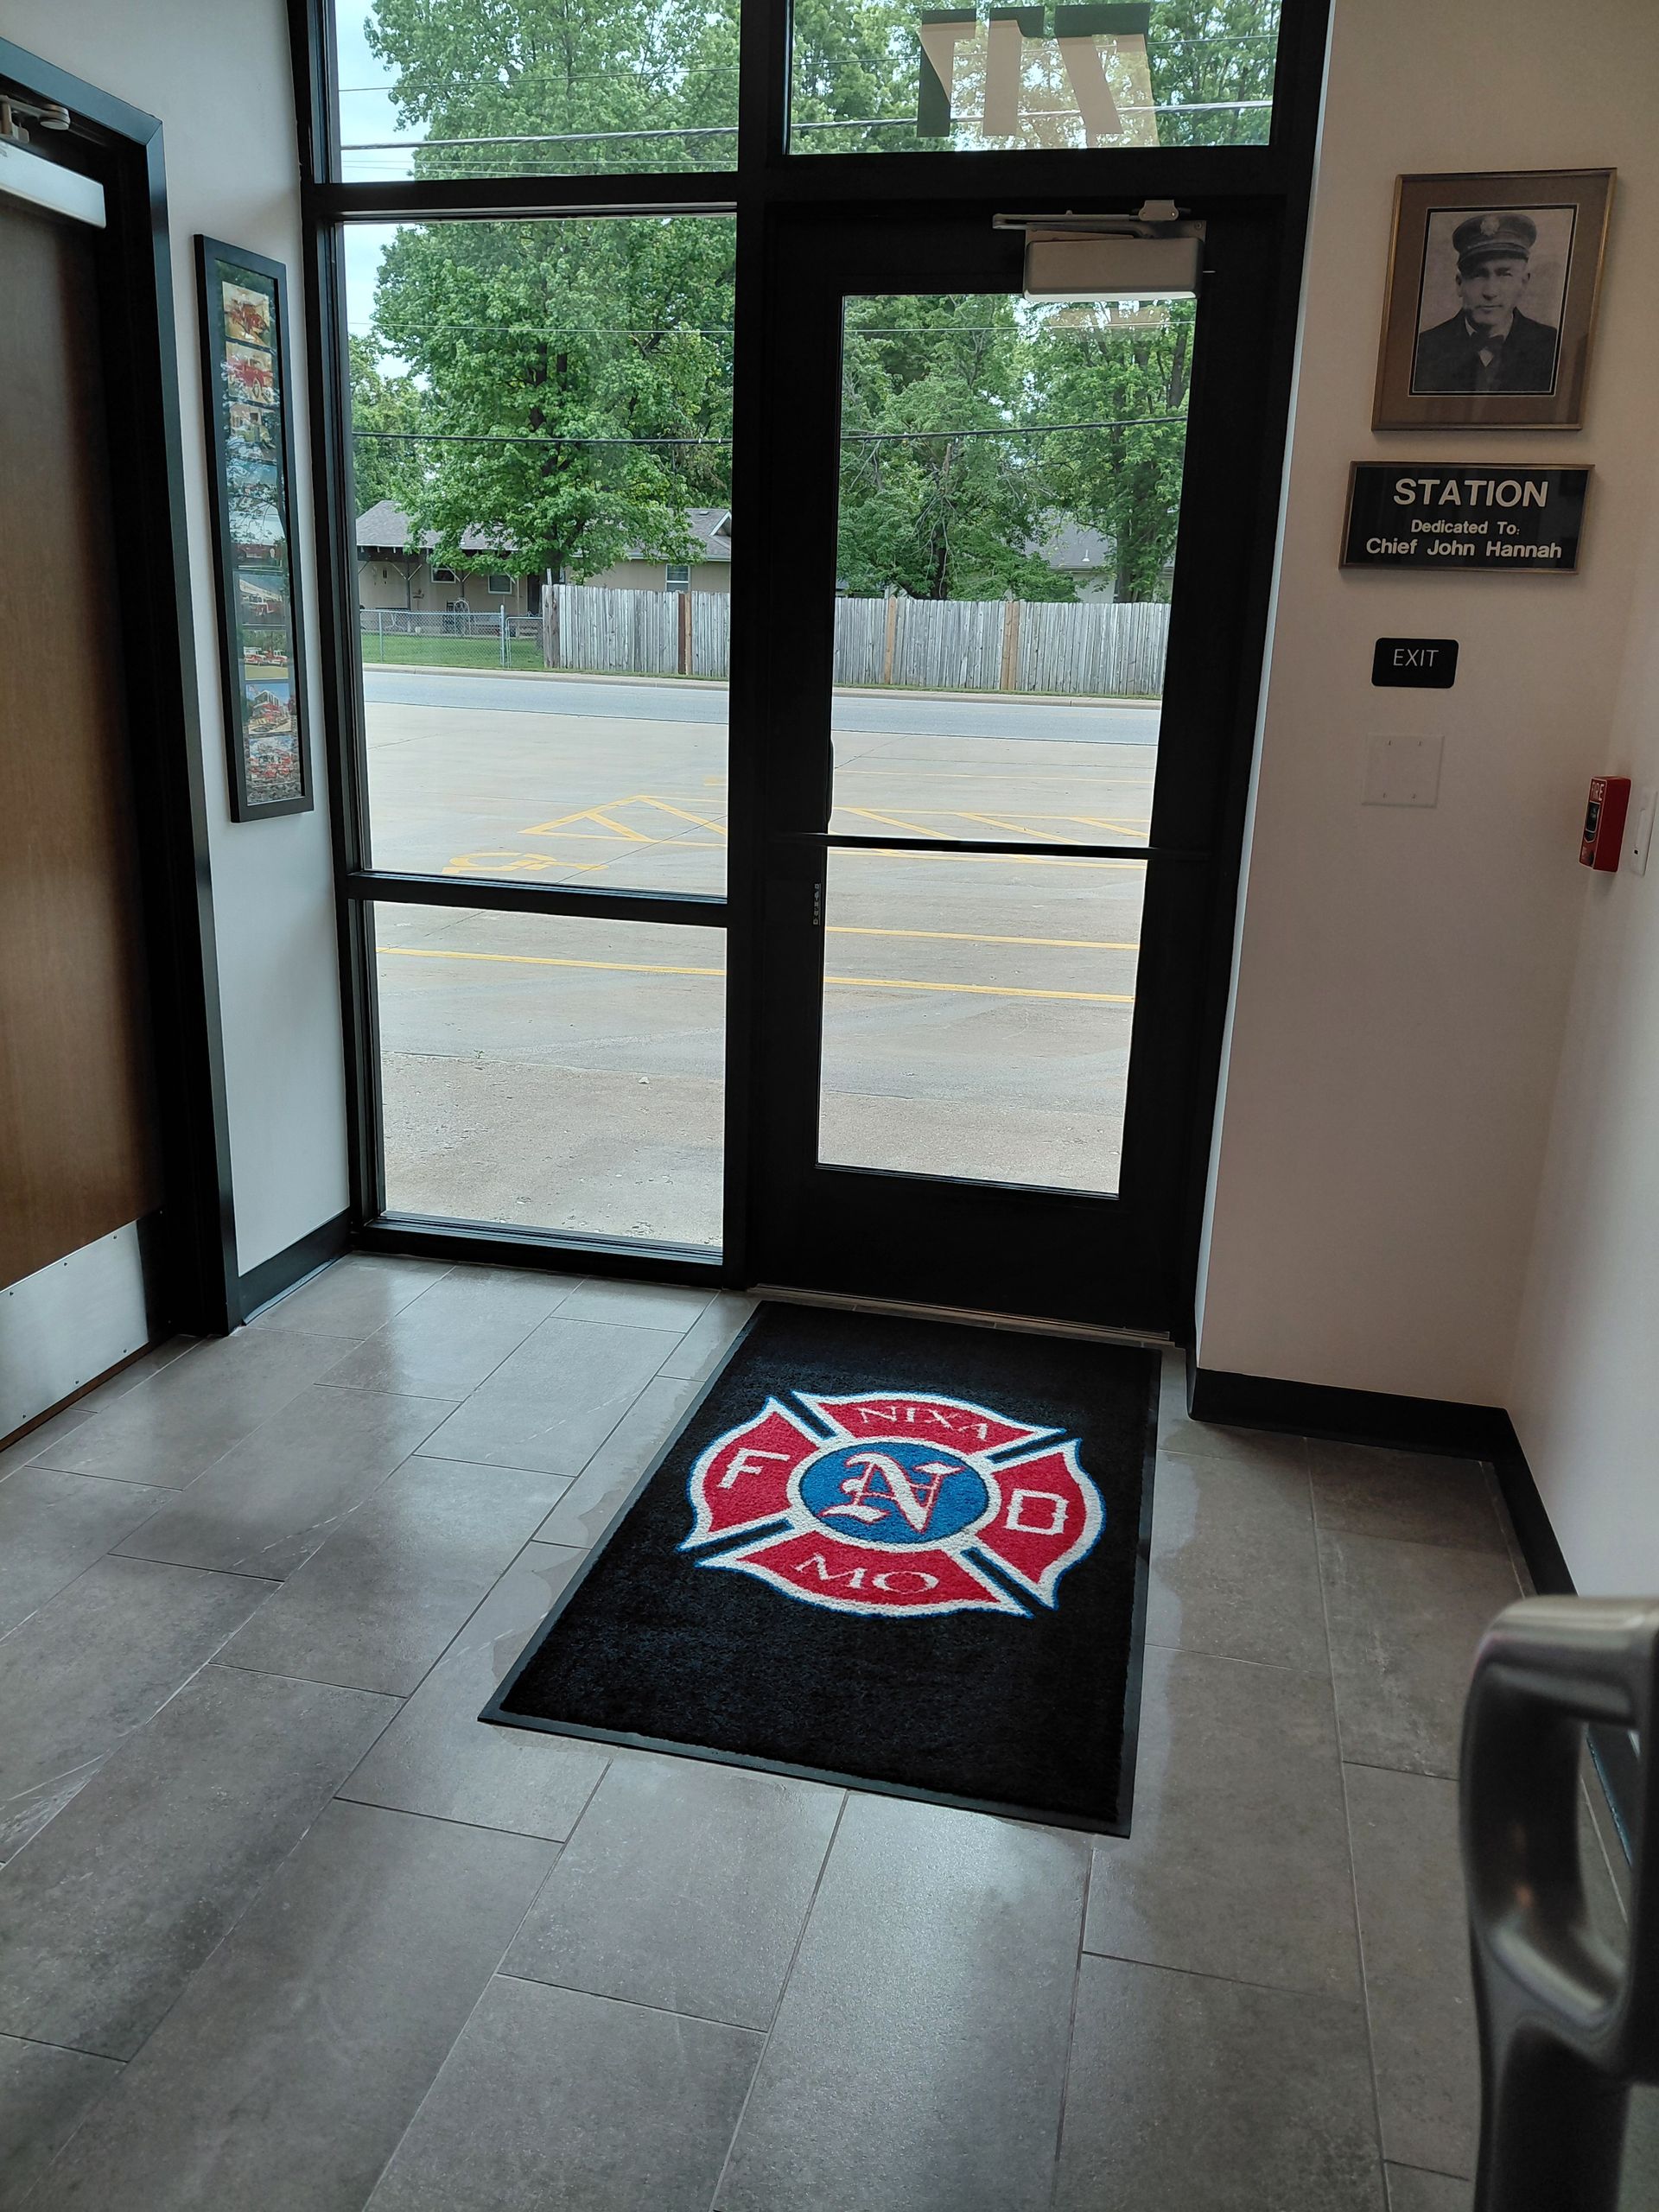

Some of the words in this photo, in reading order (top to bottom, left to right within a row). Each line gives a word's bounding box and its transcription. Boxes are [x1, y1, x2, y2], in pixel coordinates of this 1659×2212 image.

[1393, 478, 1548, 507] STATION
[1411, 519, 1488, 534] Dedicated
[1497, 521, 1521, 536] To:
[1366, 537, 1418, 555] Chief
[1427, 539, 1475, 556] John
[1486, 541, 1562, 558] Hannah
[1393, 649, 1439, 667] EXIT
[858, 1405, 989, 1440] NIXA
[717, 1448, 791, 1490] F
[819, 1452, 967, 1533] N
[1003, 1490, 1070, 1535] D
[795, 1552, 940, 1595] MO
